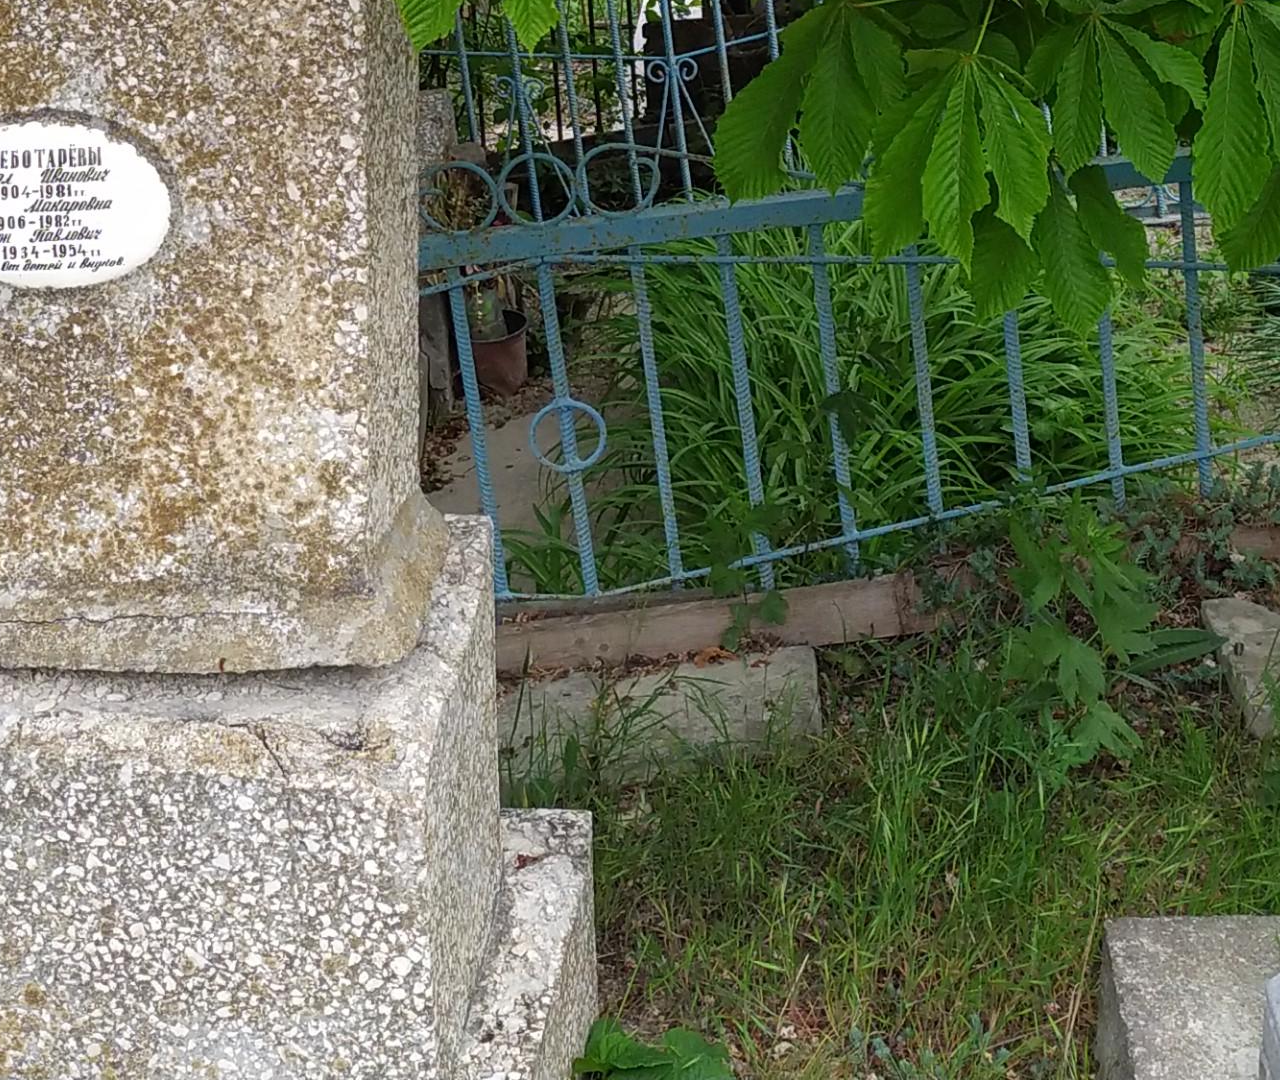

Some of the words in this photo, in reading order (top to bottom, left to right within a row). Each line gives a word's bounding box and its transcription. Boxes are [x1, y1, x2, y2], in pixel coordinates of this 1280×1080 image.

[40, 167, 111, 184] Иванович
[24, 197, 113, 214] Макаровна
[29, 226, 103, 243] Павлович
[1, 260, 20, 271] От
[22, 259, 62, 271] детей
[67, 261, 76, 269] и
